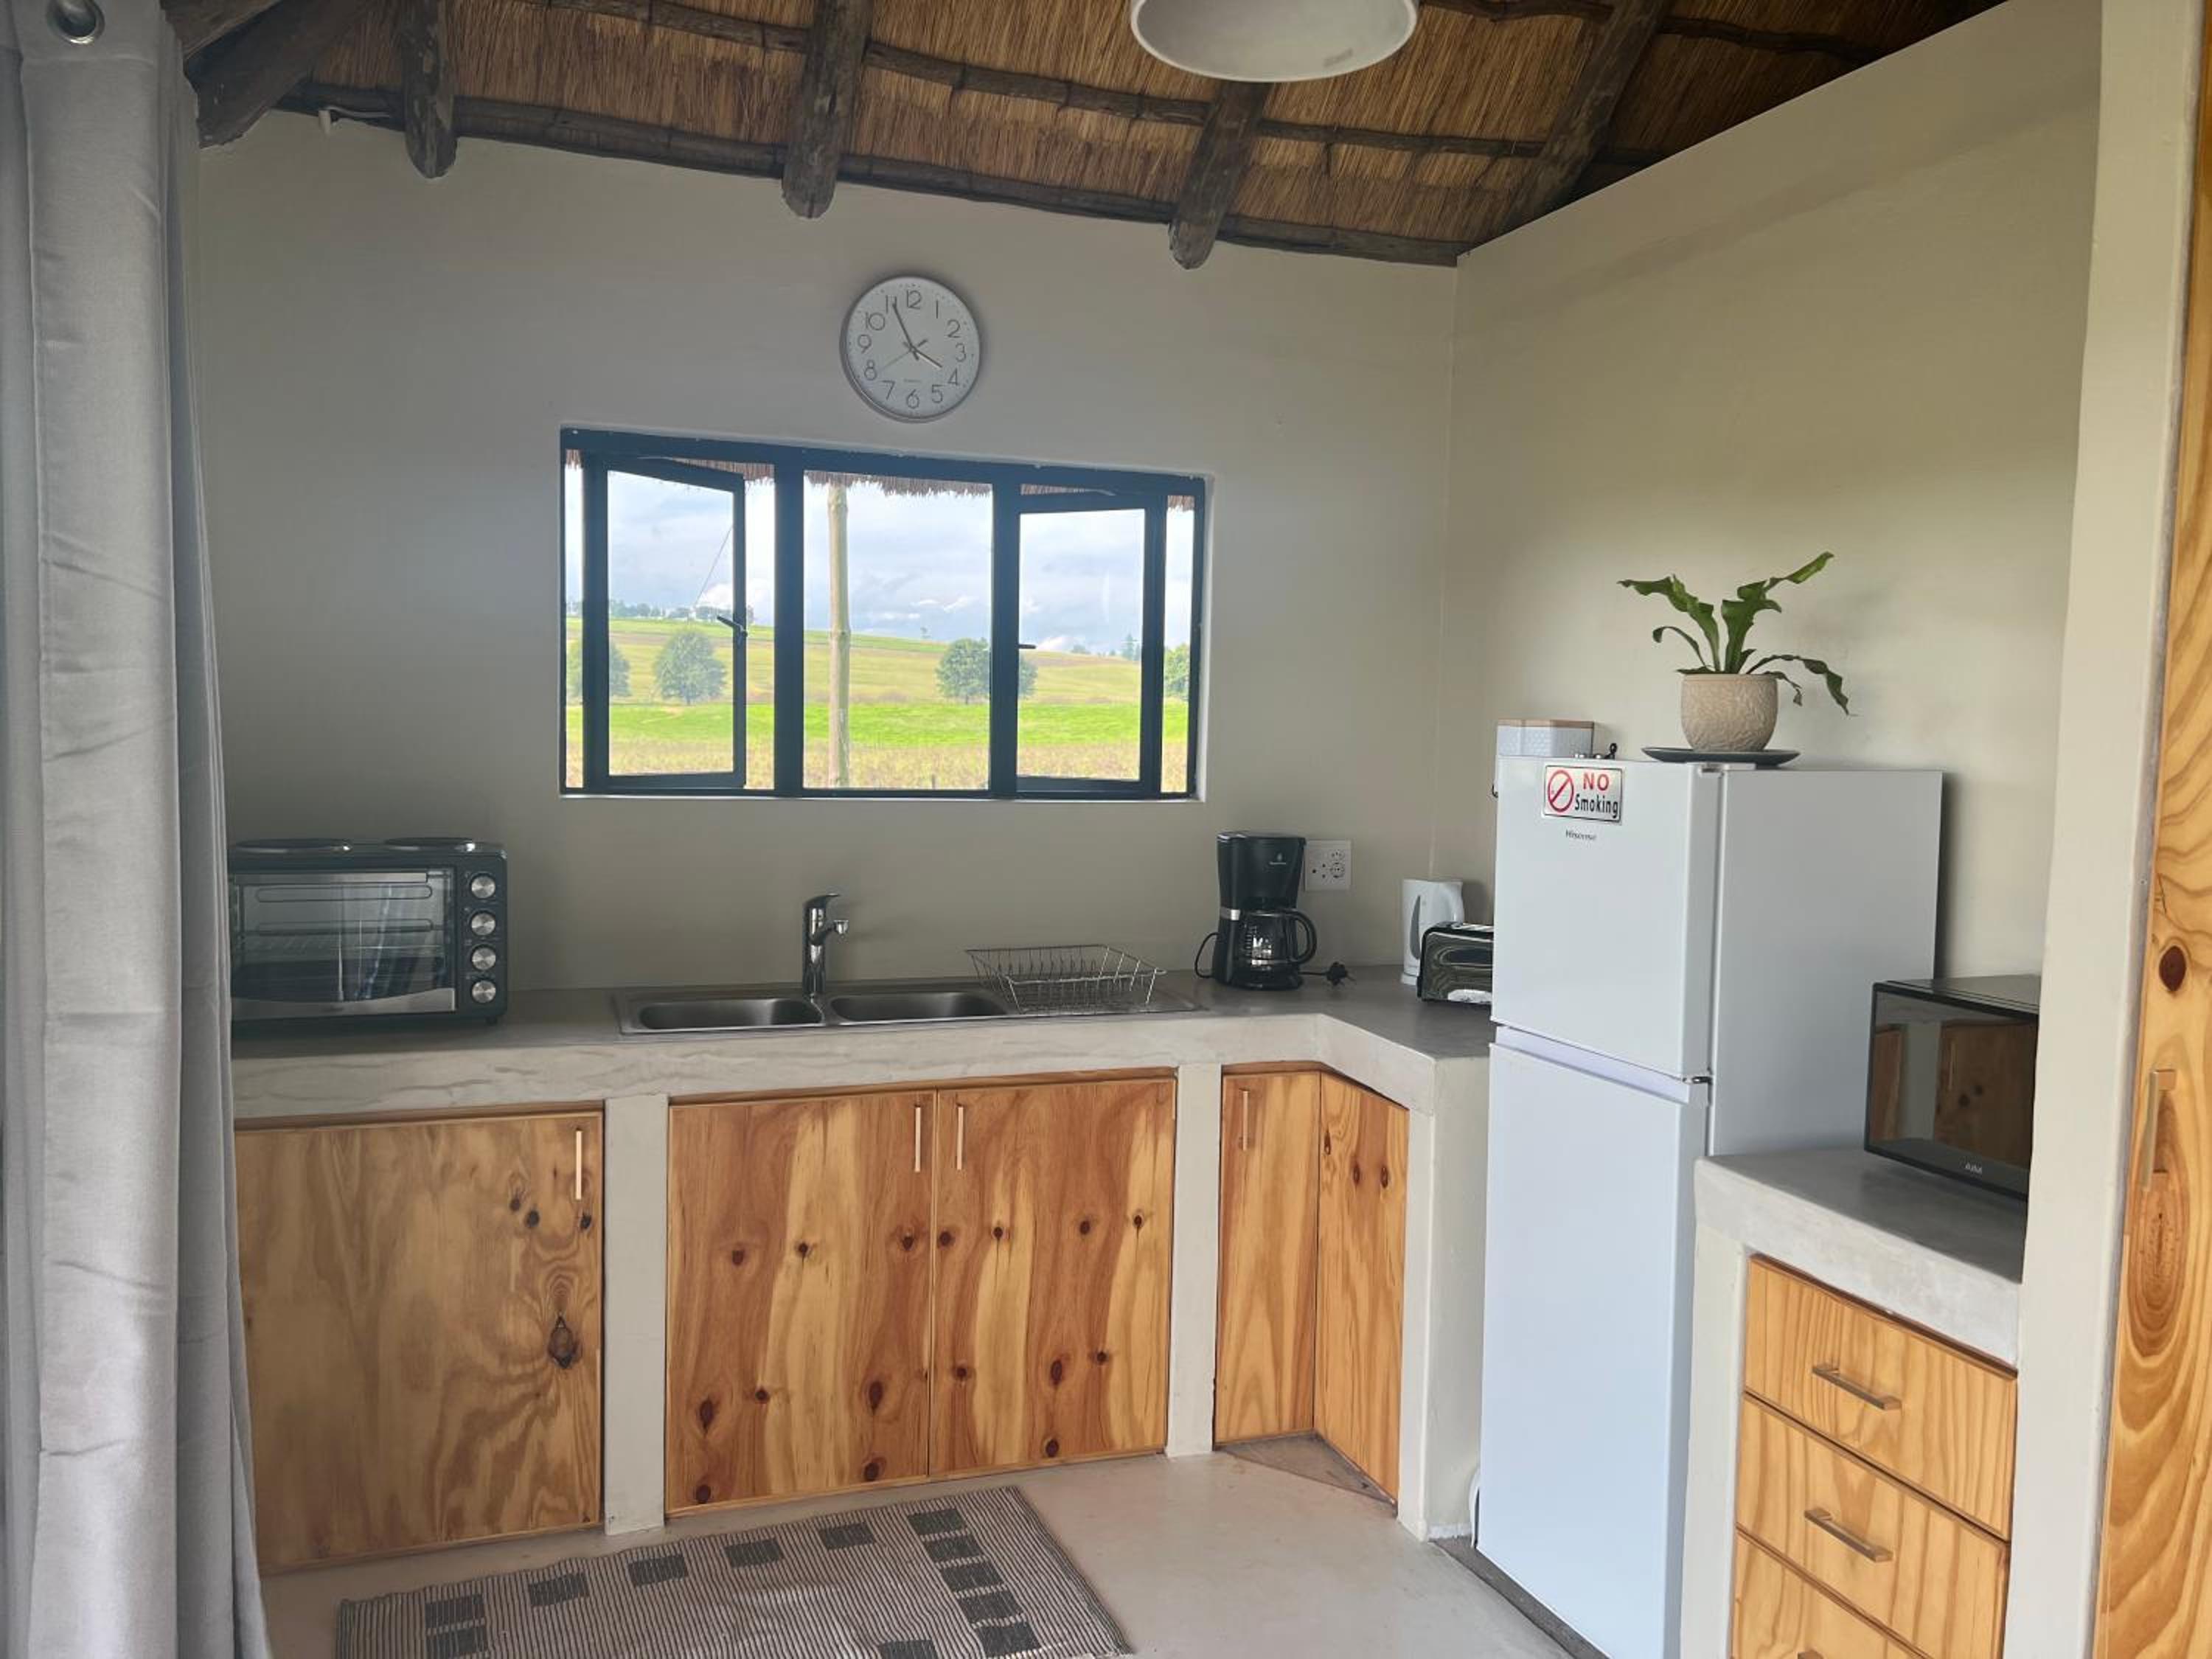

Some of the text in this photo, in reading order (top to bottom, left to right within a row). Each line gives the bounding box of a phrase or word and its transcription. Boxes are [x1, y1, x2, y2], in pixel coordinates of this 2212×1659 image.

[906, 290, 922, 310] 12
[935, 300, 939, 319] 1
[866, 312, 886, 331] 10
[947, 319, 961, 338] 2
[858, 334, 872, 354] 9
[955, 342, 967, 363] 3
[864, 359, 877, 381] 8
[947, 368, 959, 386] 4
[882, 380, 896, 400] 7
[906, 389, 919, 409] 6
[931, 383, 944, 403] 5
[1583, 772, 1610, 791] NO
[1574, 793, 1618, 818] Smoking
